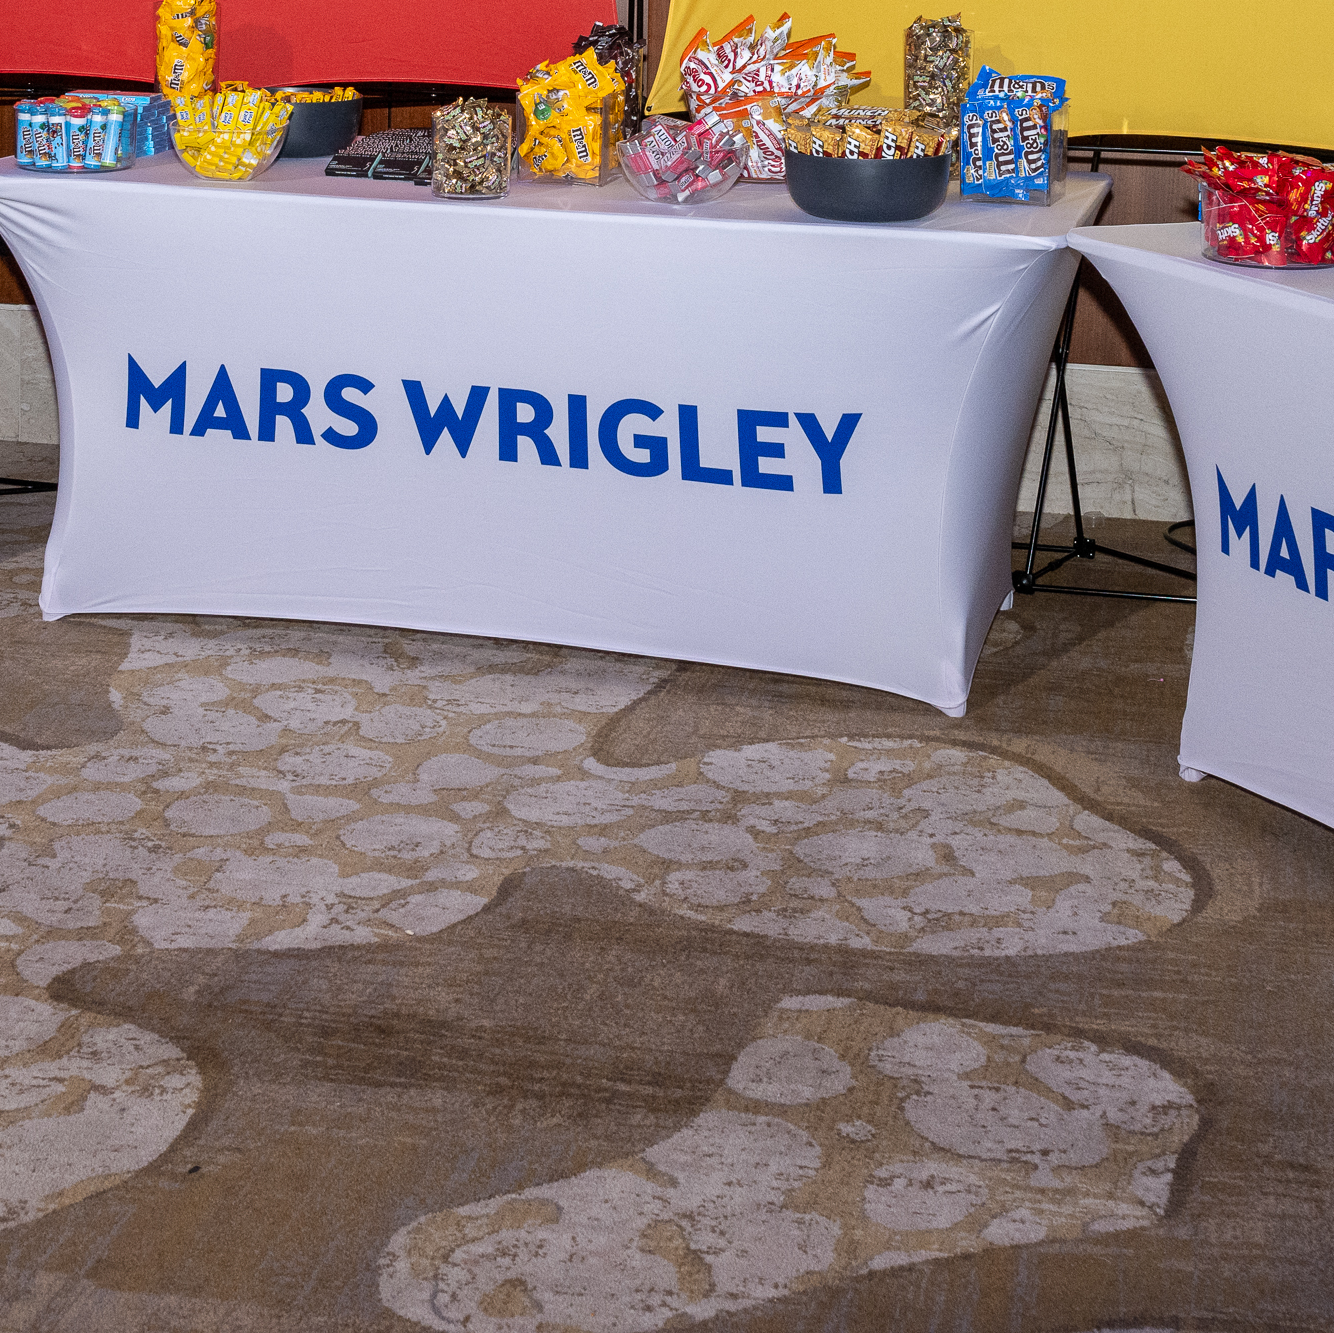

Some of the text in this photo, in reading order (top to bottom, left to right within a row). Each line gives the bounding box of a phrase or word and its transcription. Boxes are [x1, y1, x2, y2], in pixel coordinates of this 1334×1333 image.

[683, 65, 712, 95] Combos
[825, 108, 889, 116] MUNCH
[125, 352, 863, 495] MARS WRIGLEY
